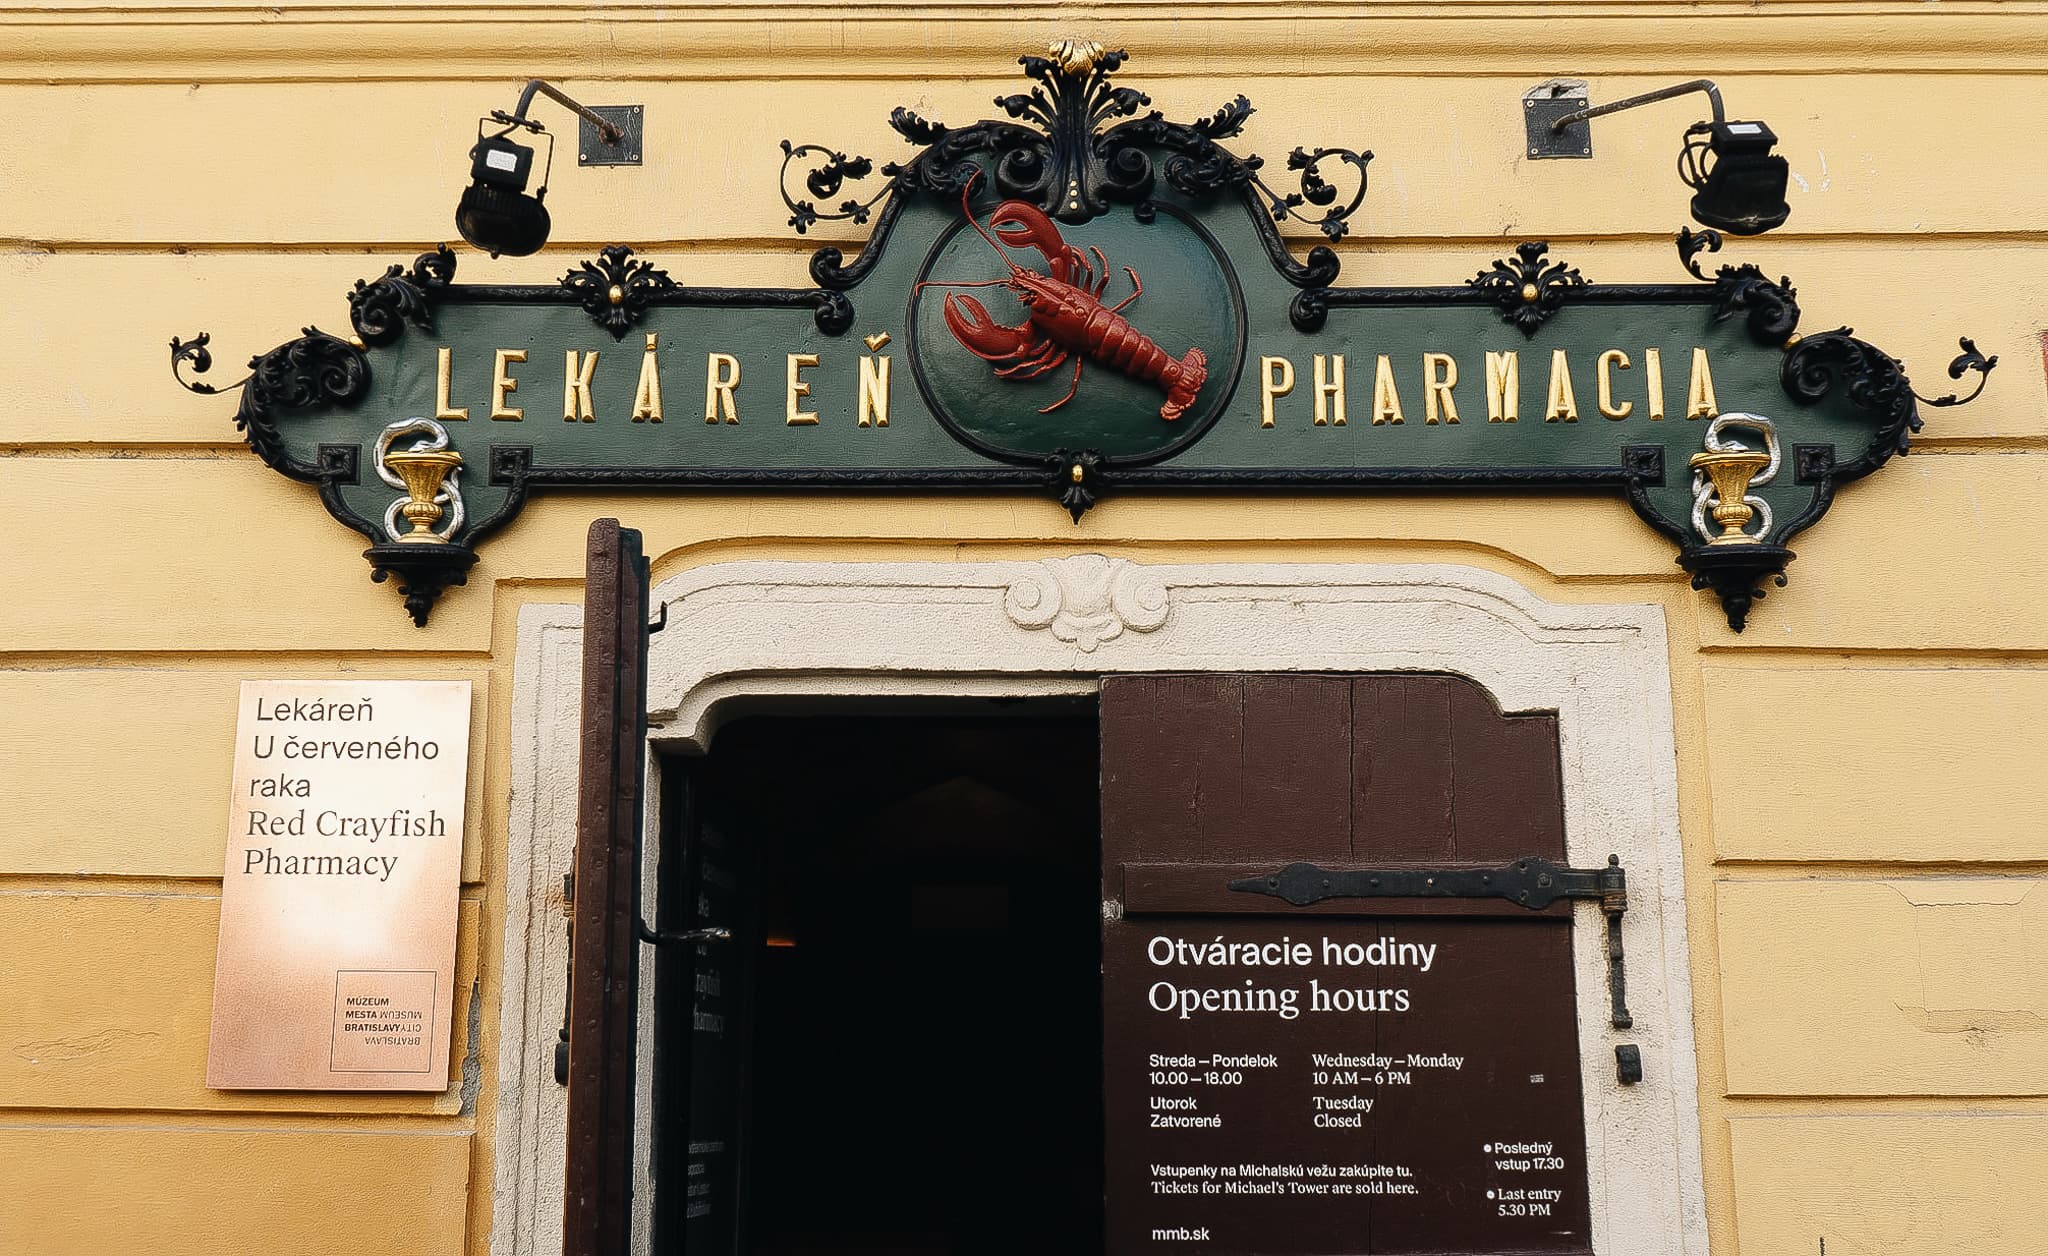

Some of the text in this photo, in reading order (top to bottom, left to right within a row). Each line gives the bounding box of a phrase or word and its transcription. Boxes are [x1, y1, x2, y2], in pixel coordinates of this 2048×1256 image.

[435, 331, 892, 427] LEKÁREŇ
[1260, 347, 1719, 428] PHARMACIA
[257, 697, 373, 722] Lekáreň
[254, 735, 439, 760] U červeného
[250, 772, 311, 798] raka
[246, 808, 446, 844] Red Crayfish
[242, 847, 399, 882] Pharmacy
[1147, 935, 1437, 972] Otváracie hodiny
[346, 995, 390, 1007] MÚZEUM
[1148, 978, 1410, 1020] Opening hours
[345, 1010, 423, 1020] MESTA MUSEUM
[344, 1023, 401, 1033] BRATISLAVY
[364, 1036, 421, 1046] BRATISLAVA
[1149, 1053, 1196, 1068] Streda
[1212, 1053, 1278, 1068] Pondelok
[1311, 1052, 1393, 1071] Wednesday
[1407, 1052, 1465, 1071] Monday
[1148, 1071, 1189, 1085] 10.00
[1203, 1071, 1243, 1085] 18.00
[1312, 1071, 1329, 1085] 10
[1332, 1071, 1359, 1085] AM
[1374, 1071, 1384, 1085] 6
[1387, 1071, 1412, 1085] PM
[1150, 1096, 1198, 1110] Utorok
[1312, 1095, 1374, 1113] Tuesday
[1150, 1113, 1222, 1128] Zatvorené
[1313, 1112, 1362, 1128] Closed
[1494, 1141, 1553, 1156] Posledný
[1150, 1163, 1218, 1180] Vstupenky
[1220, 1166, 1237, 1177] na
[1306, 1164, 1337, 1177] vežu
[1339, 1164, 1394, 1180] zakúpite
[1396, 1165, 1413, 1177] tu.
[1494, 1156, 1565, 1173] vstup 17.30
[1150, 1180, 1419, 1195] Tickets for Michael's Tower are sold here.
[1497, 1188, 1562, 1203] Last entry
[1497, 1203, 1551, 1217] 5.30 PM
[1152, 1226, 1210, 1241] mmb.sk
